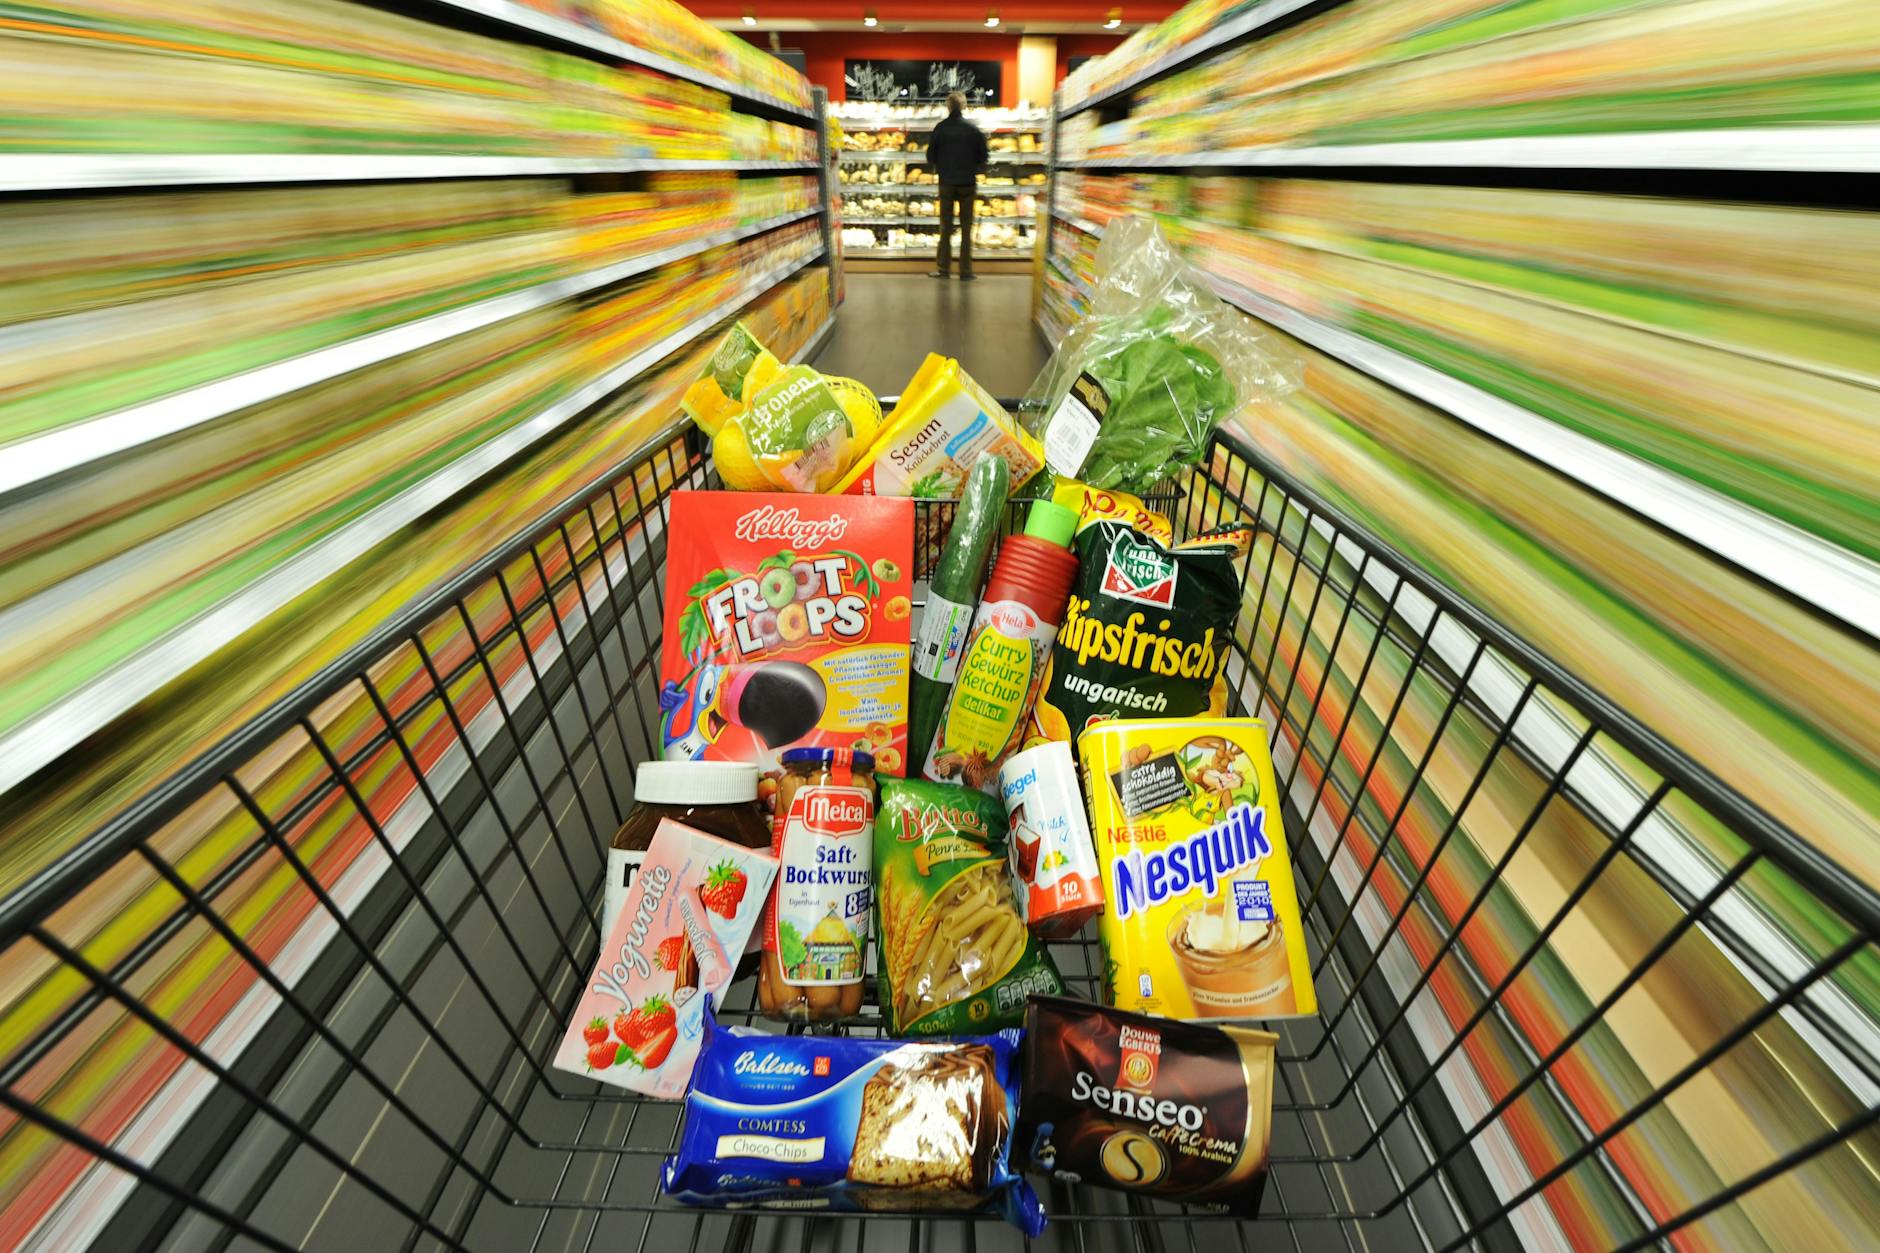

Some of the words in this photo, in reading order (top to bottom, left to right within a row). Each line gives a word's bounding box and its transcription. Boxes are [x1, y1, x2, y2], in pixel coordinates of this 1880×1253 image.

[890, 417, 942, 466] Sesam
[904, 430, 951, 475] Knäckebrot
[736, 505, 848, 549] Kellogg's
[706, 558, 847, 633] FROOT
[734, 595, 866, 655] LOOPS
[1001, 611, 1024, 629] Hela
[980, 635, 1027, 664] Curry
[970, 652, 1024, 685] Gewürz
[963, 669, 1021, 703] Ketchup
[1064, 673, 1168, 713] ungarisch
[964, 696, 1002, 720] delikat
[1122, 766, 1177, 793] schokoladig
[1131, 763, 1156, 779] extra
[808, 797, 864, 823] Meica
[816, 844, 858, 863] Saft-
[1115, 804, 1271, 917] Nesquik
[1062, 880, 1078, 896] 10
[1239, 896, 1270, 905] 2010
[847, 893, 858, 915] 8
[592, 863, 671, 1013] Yogurette
[1119, 1036, 1161, 1055] EGBERTS
[1121, 1025, 1161, 1042] Douwe
[734, 1051, 810, 1076] Bahlsen
[1071, 1071, 1203, 1131] Senseo
[738, 1118, 806, 1134] COMTESS
[733, 1139, 807, 1158] Choco-Chips
[1179, 1144, 1199, 1157] 100%
[1201, 1149, 1232, 1164] Arabica
